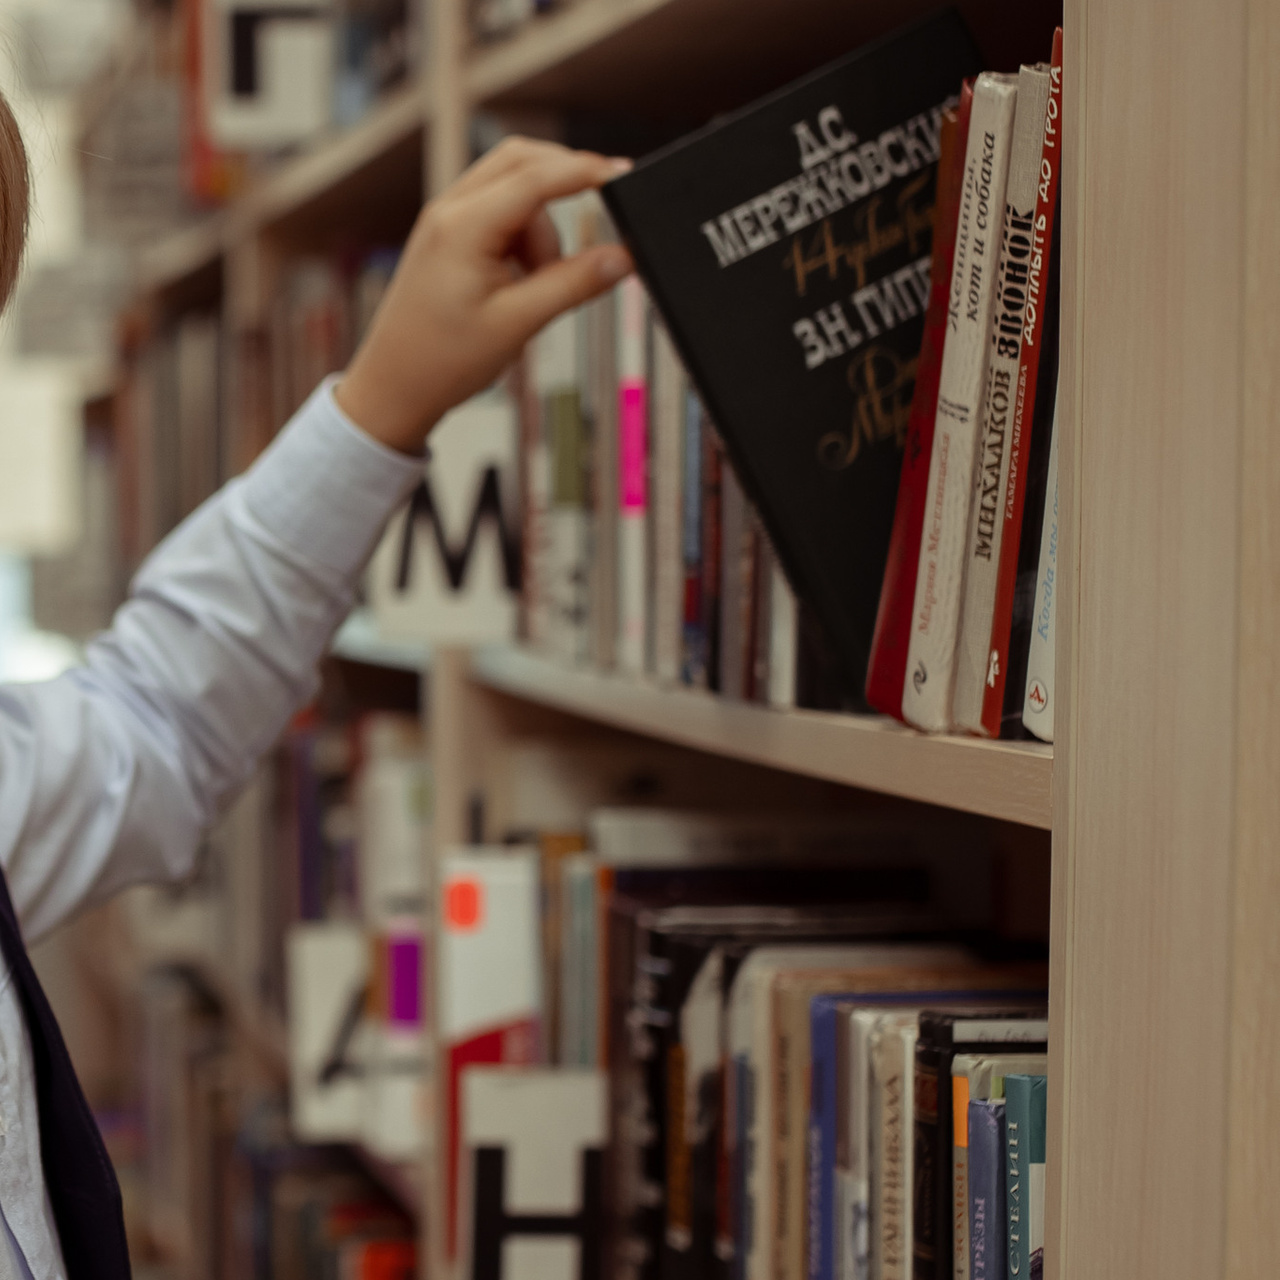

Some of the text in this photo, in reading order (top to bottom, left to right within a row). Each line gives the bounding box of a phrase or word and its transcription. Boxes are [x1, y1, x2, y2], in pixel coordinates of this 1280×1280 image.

[965, 131, 996, 323] кот и собака
[997, 204, 1034, 360] ЗВОНОК
[1023, 65, 1062, 346] ДОПЛЫТЬ ДО ГРОТА
[975, 370, 1010, 561] МИХАЛКОВ
[1005, 364, 1029, 519] ТАМАРА МИХЕЕВА
[1036, 568, 1054, 642] Когда
